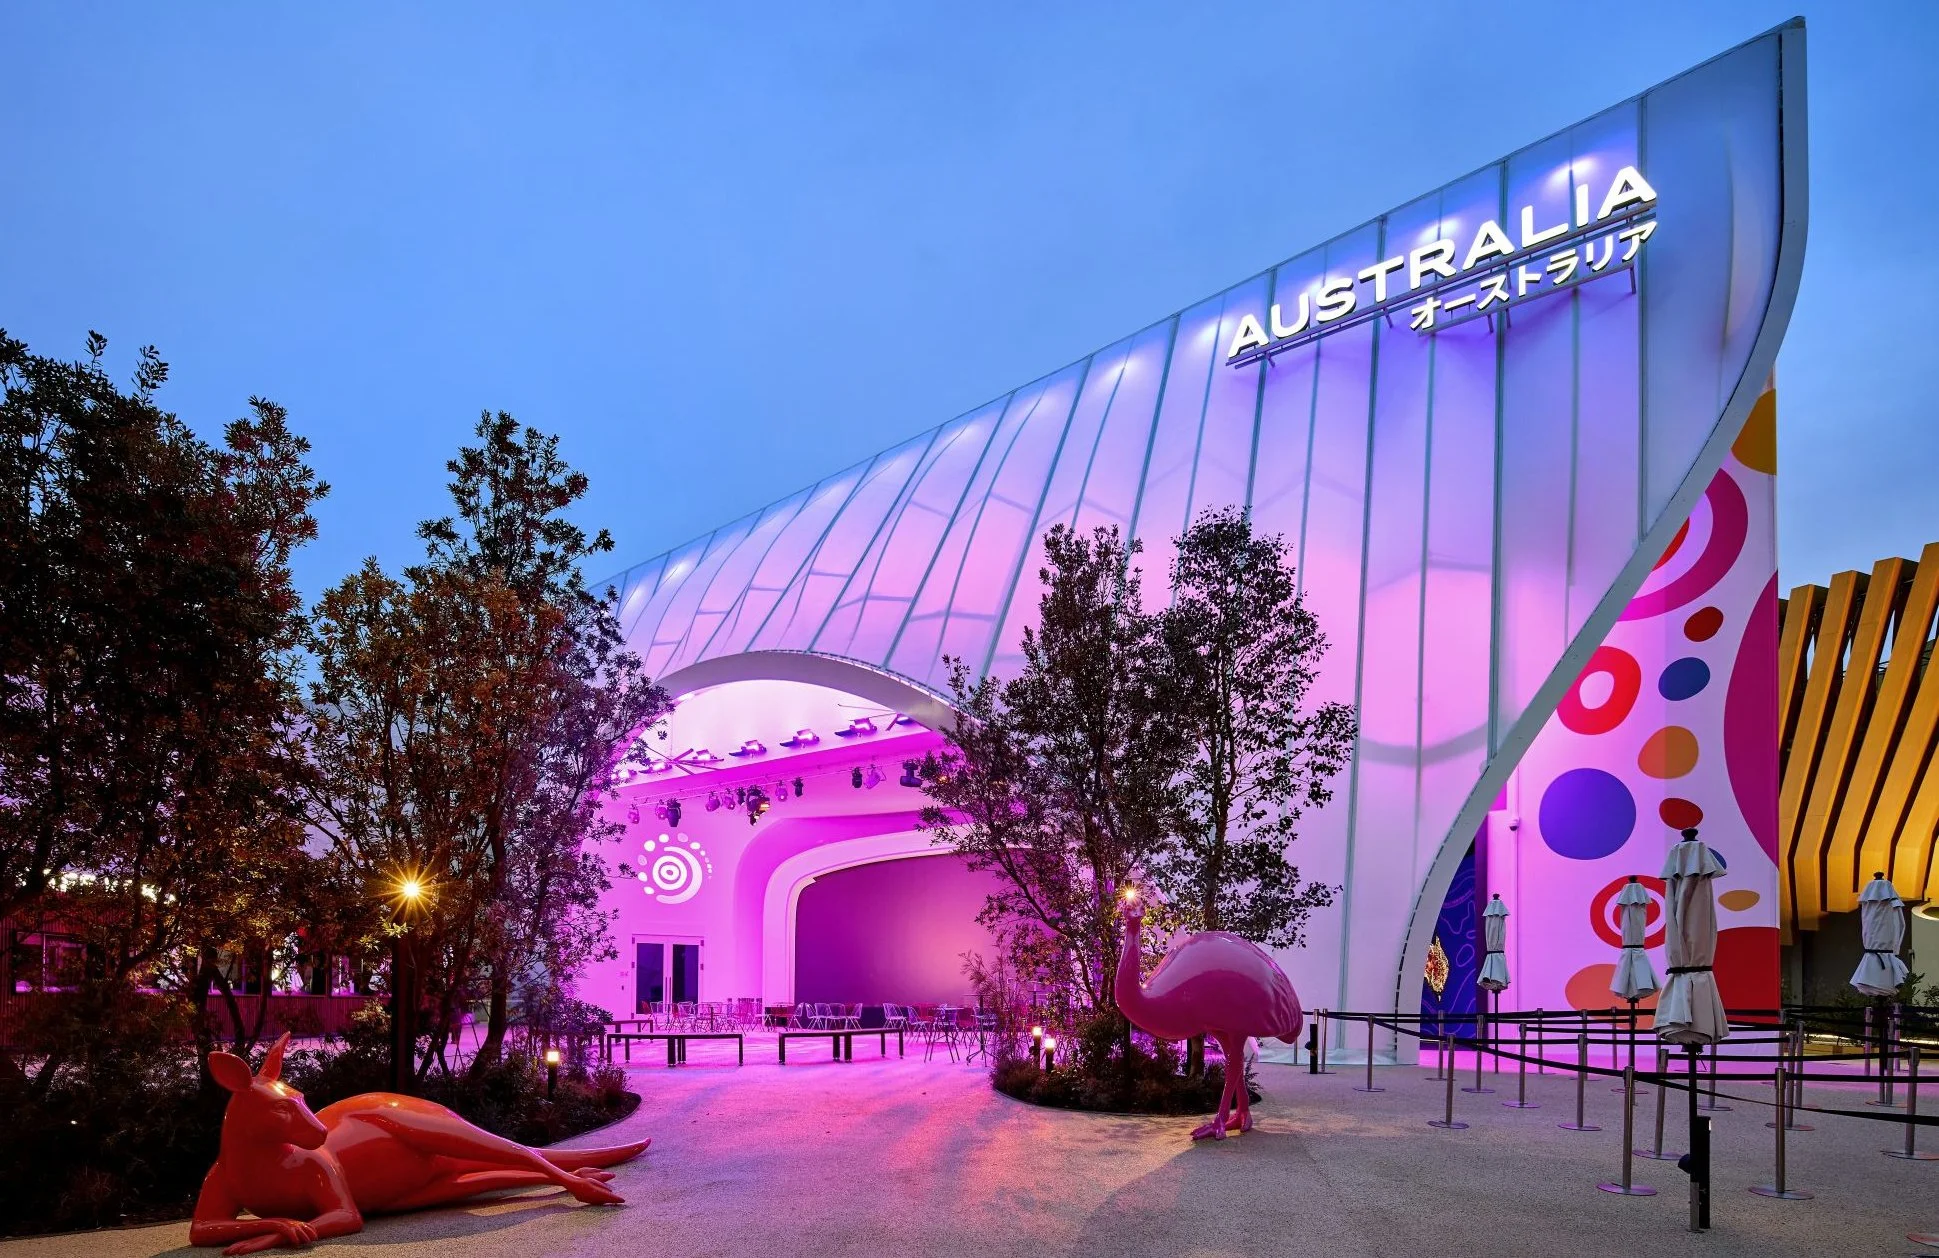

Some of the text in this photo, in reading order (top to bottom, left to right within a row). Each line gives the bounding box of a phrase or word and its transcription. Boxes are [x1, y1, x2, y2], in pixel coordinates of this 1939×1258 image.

[1228, 166, 1657, 357] AUSTRALIA
[1410, 221, 1657, 331] オーストラリア
